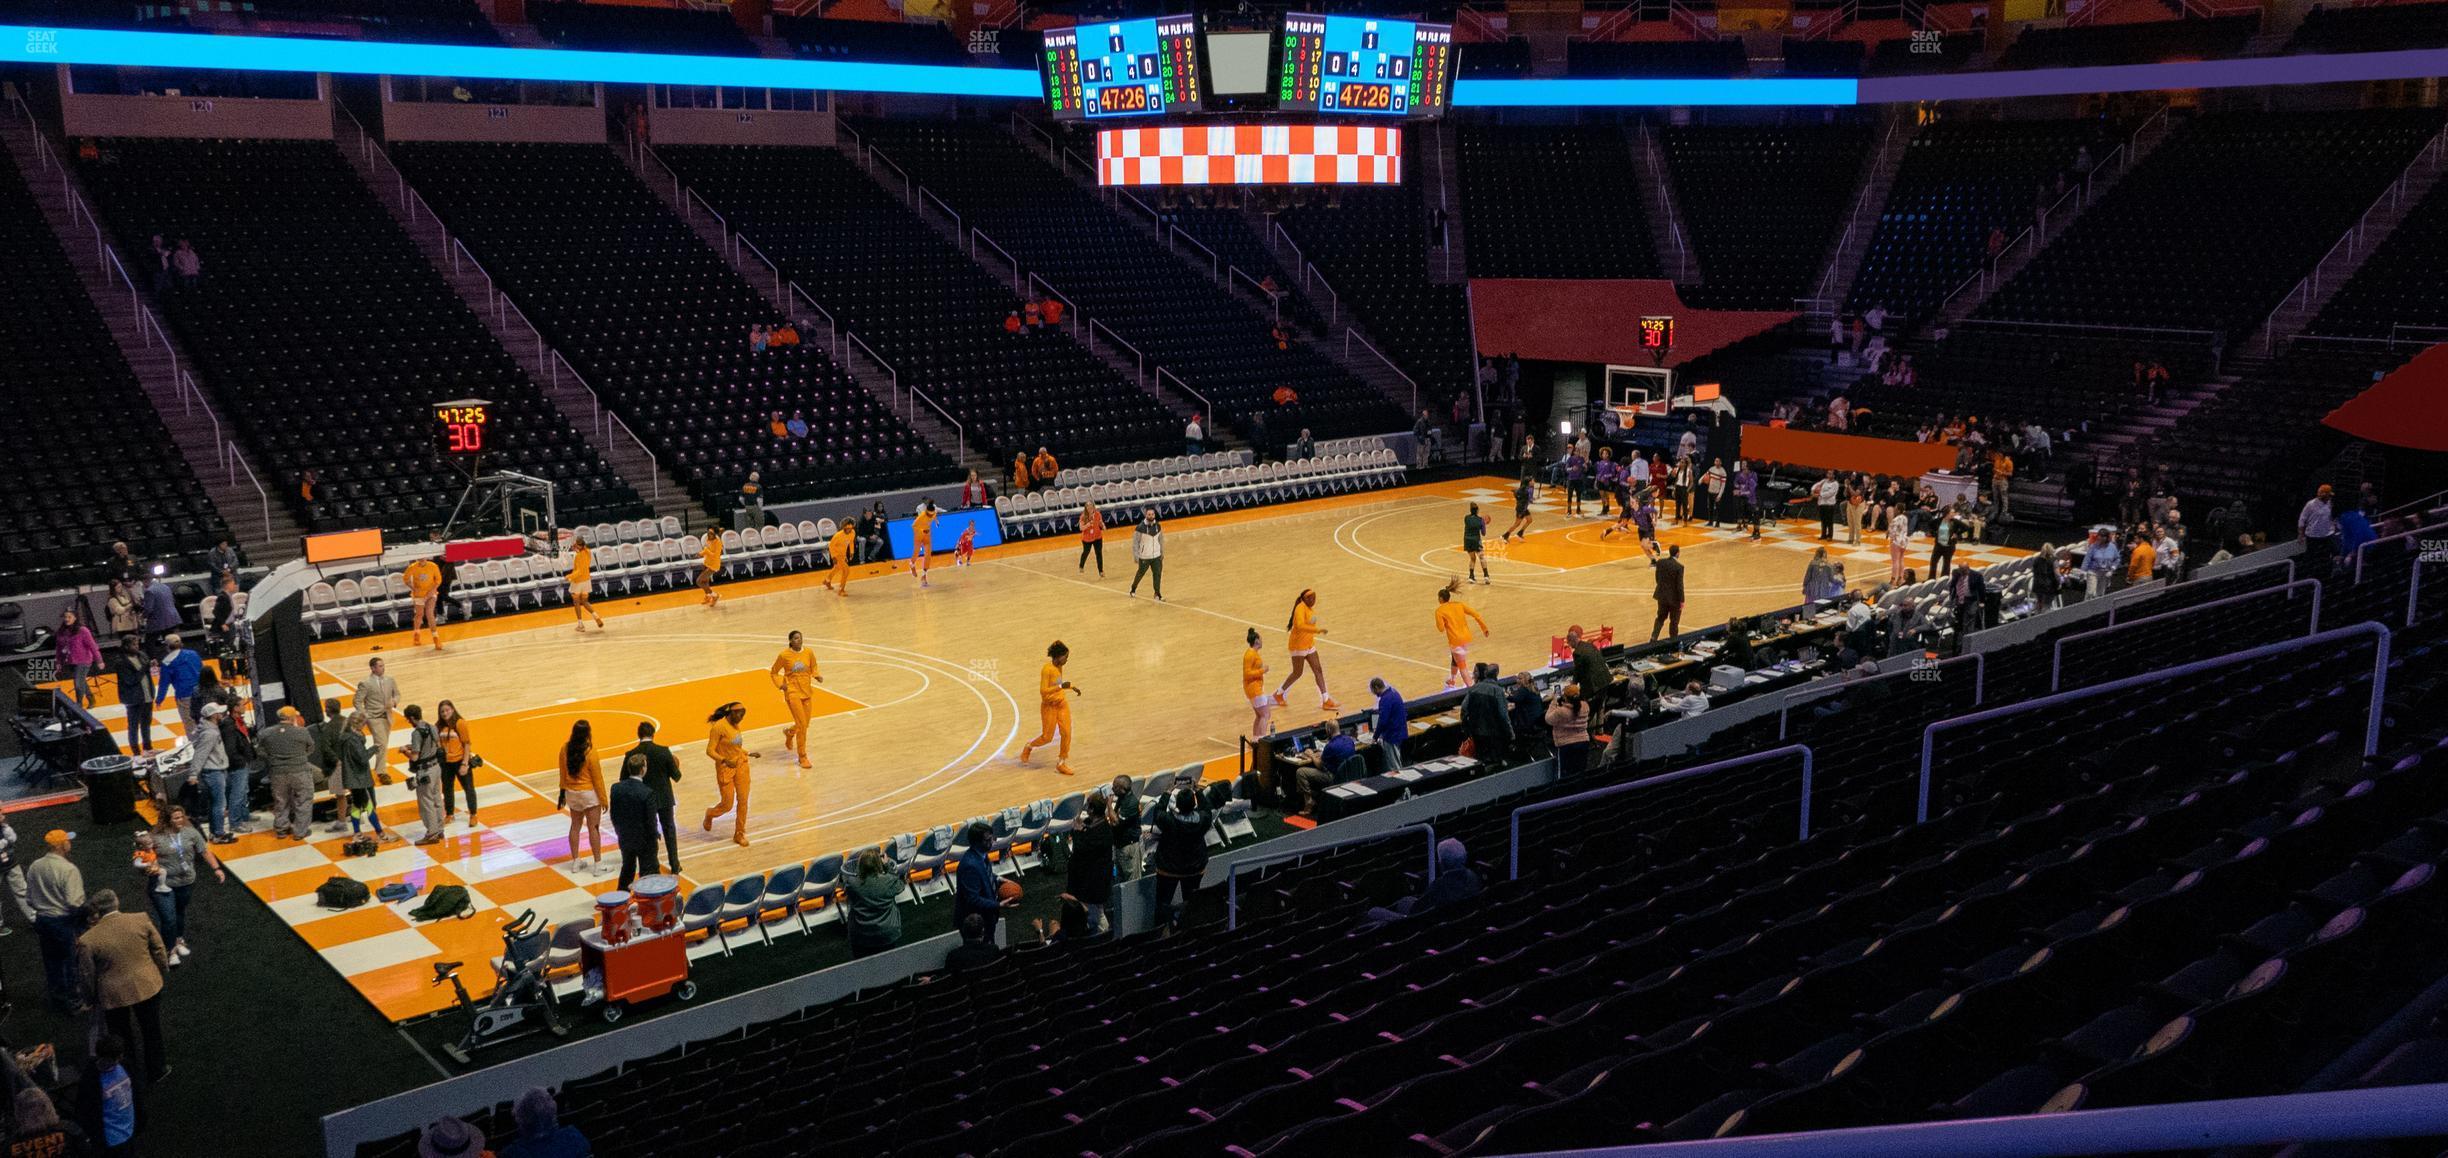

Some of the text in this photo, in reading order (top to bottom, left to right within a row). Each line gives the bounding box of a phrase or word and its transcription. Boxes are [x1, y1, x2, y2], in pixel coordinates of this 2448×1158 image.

[1115, 36, 1120, 52] 1
[1174, 38, 1180, 49] 0
[1185, 38, 1191, 49] 0
[1314, 38, 1320, 49] 9
[1367, 34, 1373, 48] 1
[1311, 51, 1322, 62] 17
[1430, 45, 1435, 56] 0
[1439, 46, 1445, 57] 0
[1162, 52, 1192, 64] 11 0 7
[1413, 58, 1444, 69] 11 0 7
[1070, 61, 1078, 72] 17
[1144, 58, 1152, 75] 0
[1332, 56, 1340, 73] 0
[1351, 65, 1358, 76] 4
[1395, 59, 1403, 76] 0
[1088, 63, 1095, 79] 0
[1105, 70, 1112, 80] 4
[1129, 67, 1135, 78] 4
[1162, 65, 1193, 77] 20 2 7
[1377, 66, 1383, 77] 4
[1412, 70, 1443, 82] 20 2 7
[1164, 80, 1173, 90] 21
[1190, 78, 1195, 88] 2
[1309, 78, 1319, 89] 10
[1411, 83, 1420, 93] 21
[1436, 84, 1441, 94] 2
[1072, 86, 1081, 97] 10
[1165, 91, 1196, 103] 24 0 0
[1296, 89, 1302, 100] 0
[1310, 90, 1316, 101] 0
[1340, 85, 1389, 107] 47:26
[1075, 98, 1080, 108] 0
[1101, 87, 1145, 110] 47:26
[1152, 97, 1158, 108] 0
[1326, 95, 1332, 106] 0
[1395, 97, 1401, 109] 0
[1410, 95, 1440, 107] 24 0 0
[191, 100, 213, 112] 120
[1089, 101, 1095, 112] 0
[1641, 320, 1664, 330] 47:25
[1645, 330, 1661, 346] 30
[439, 407, 485, 423] 47:25
[448, 423, 481, 450] 30
[10, 1131, 65, 1155] EVENT
